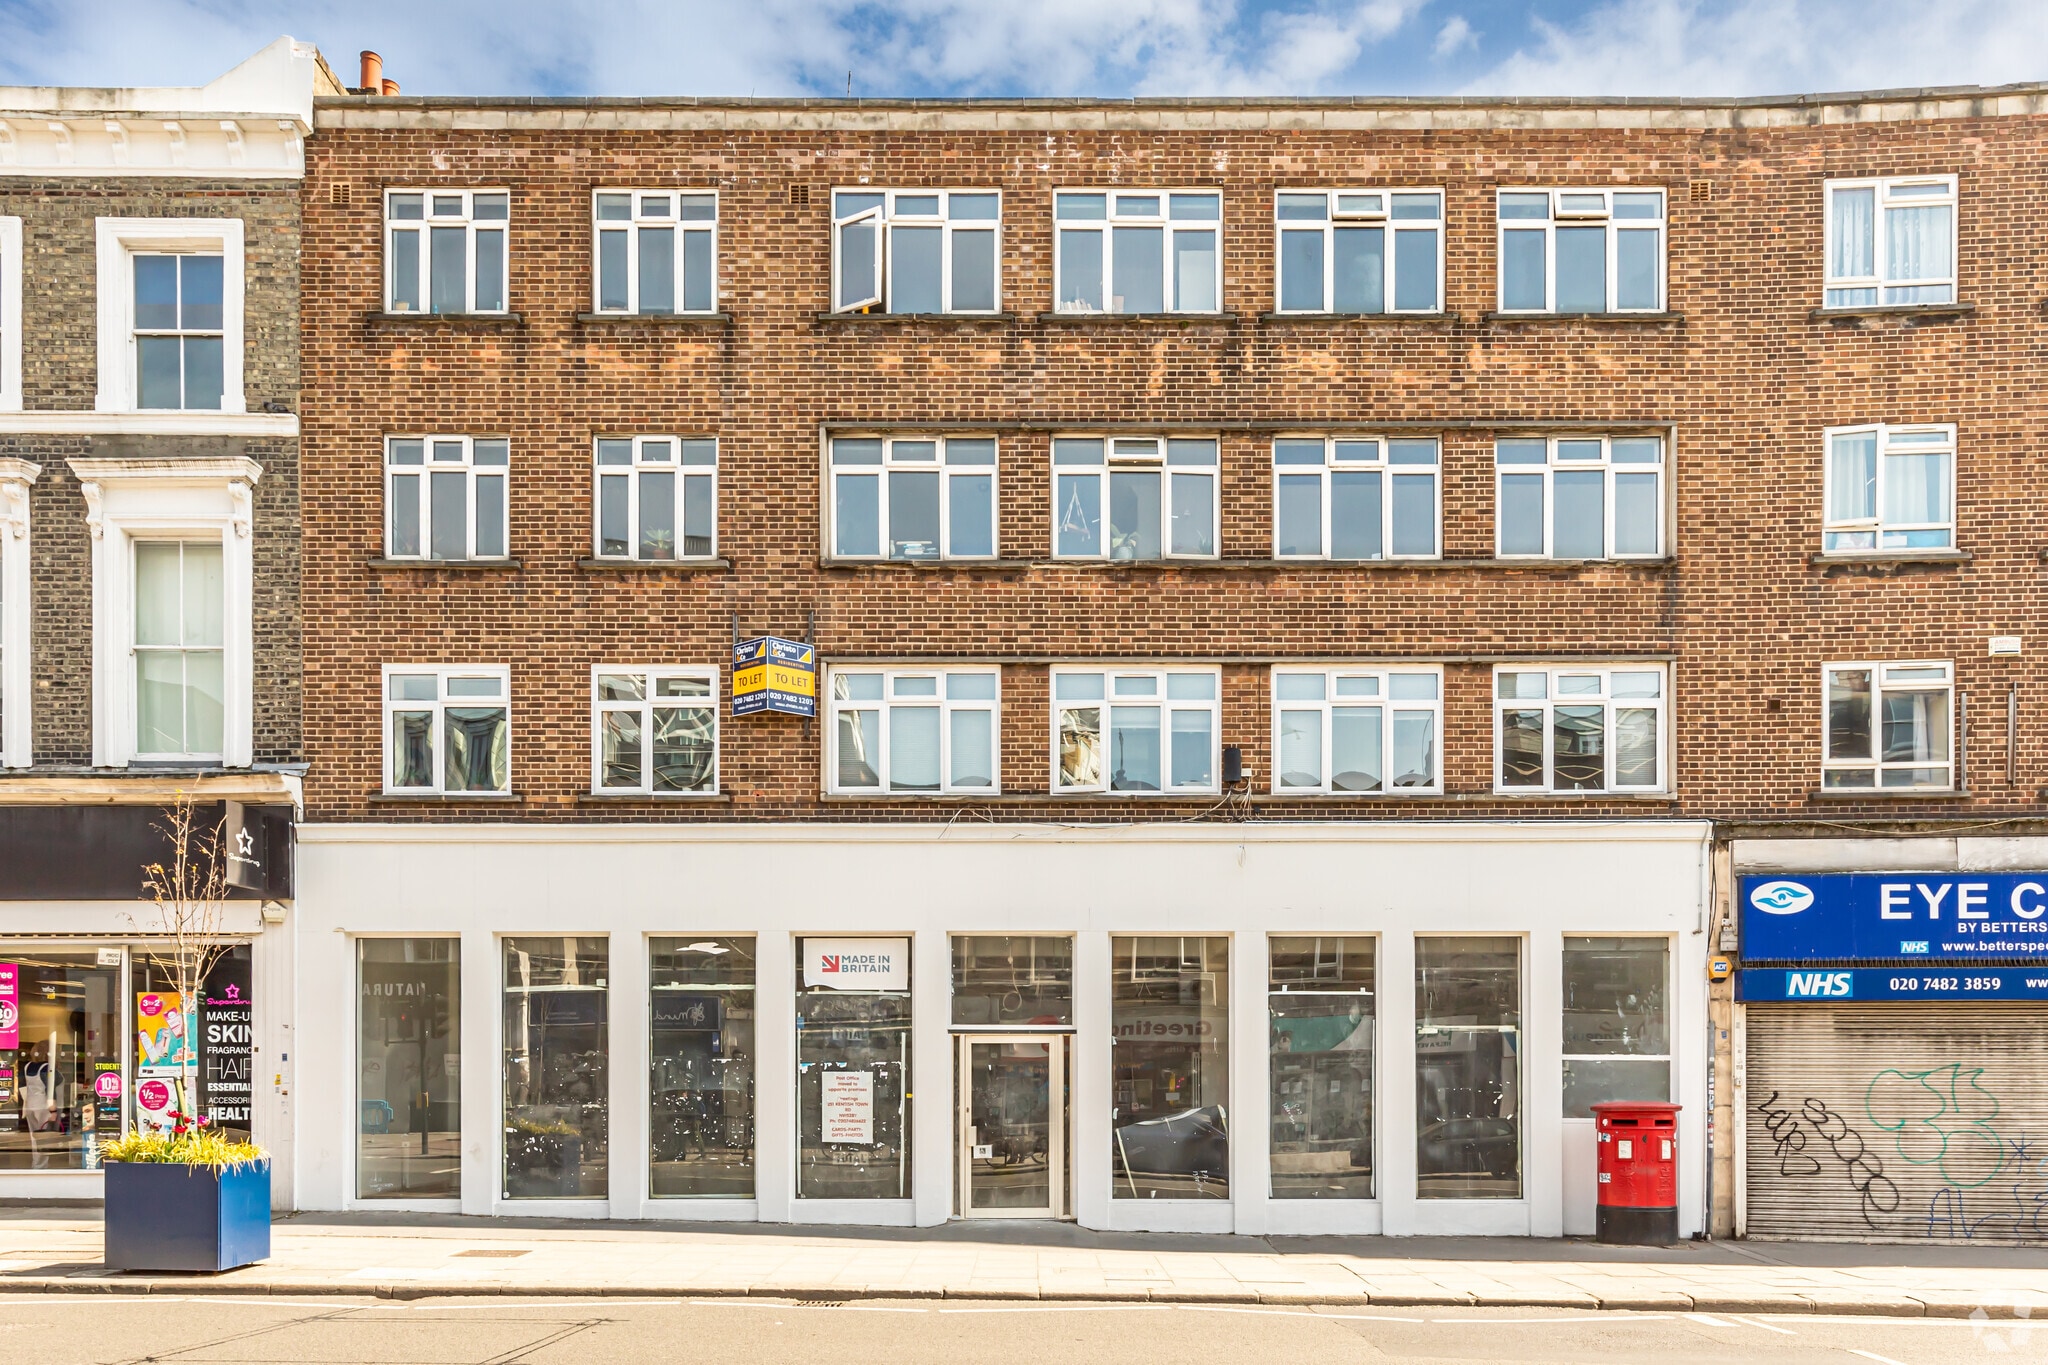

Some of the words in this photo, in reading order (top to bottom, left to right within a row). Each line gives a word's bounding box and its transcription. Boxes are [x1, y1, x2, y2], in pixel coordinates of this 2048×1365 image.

[772, 642, 796, 653] Christo
[778, 650, 785, 658] Co
[738, 677, 748, 687] TO
[750, 673, 762, 684] LET
[775, 673, 788, 684] TO
[792, 678, 808, 688] LET
[755, 692, 766, 700] 1203
[770, 692, 782, 700] 020
[782, 694, 798, 702] 7482
[798, 696, 813, 706] 1203
[1880, 883, 1989, 920] EYE
[2010, 882, 2046, 919] C
[1958, 922, 1977, 933] BY
[1982, 922, 2048, 933] BETTERS
[1902, 942, 1928, 952] NHS
[1942, 940, 2048, 953] www.betterspe
[842, 955, 876, 964] MADE
[878, 955, 890, 964] IN
[842, 964, 890, 972] BRITAIN
[1715, 963, 1726, 971] ADT
[1788, 974, 1851, 996] NHS
[1890, 978, 1918, 991] 020
[1923, 978, 1958, 990] 7482
[1964, 978, 2001, 990] 3859
[206, 1012, 252, 1021] MAKE-U
[208, 1108, 252, 1120] HEALT
